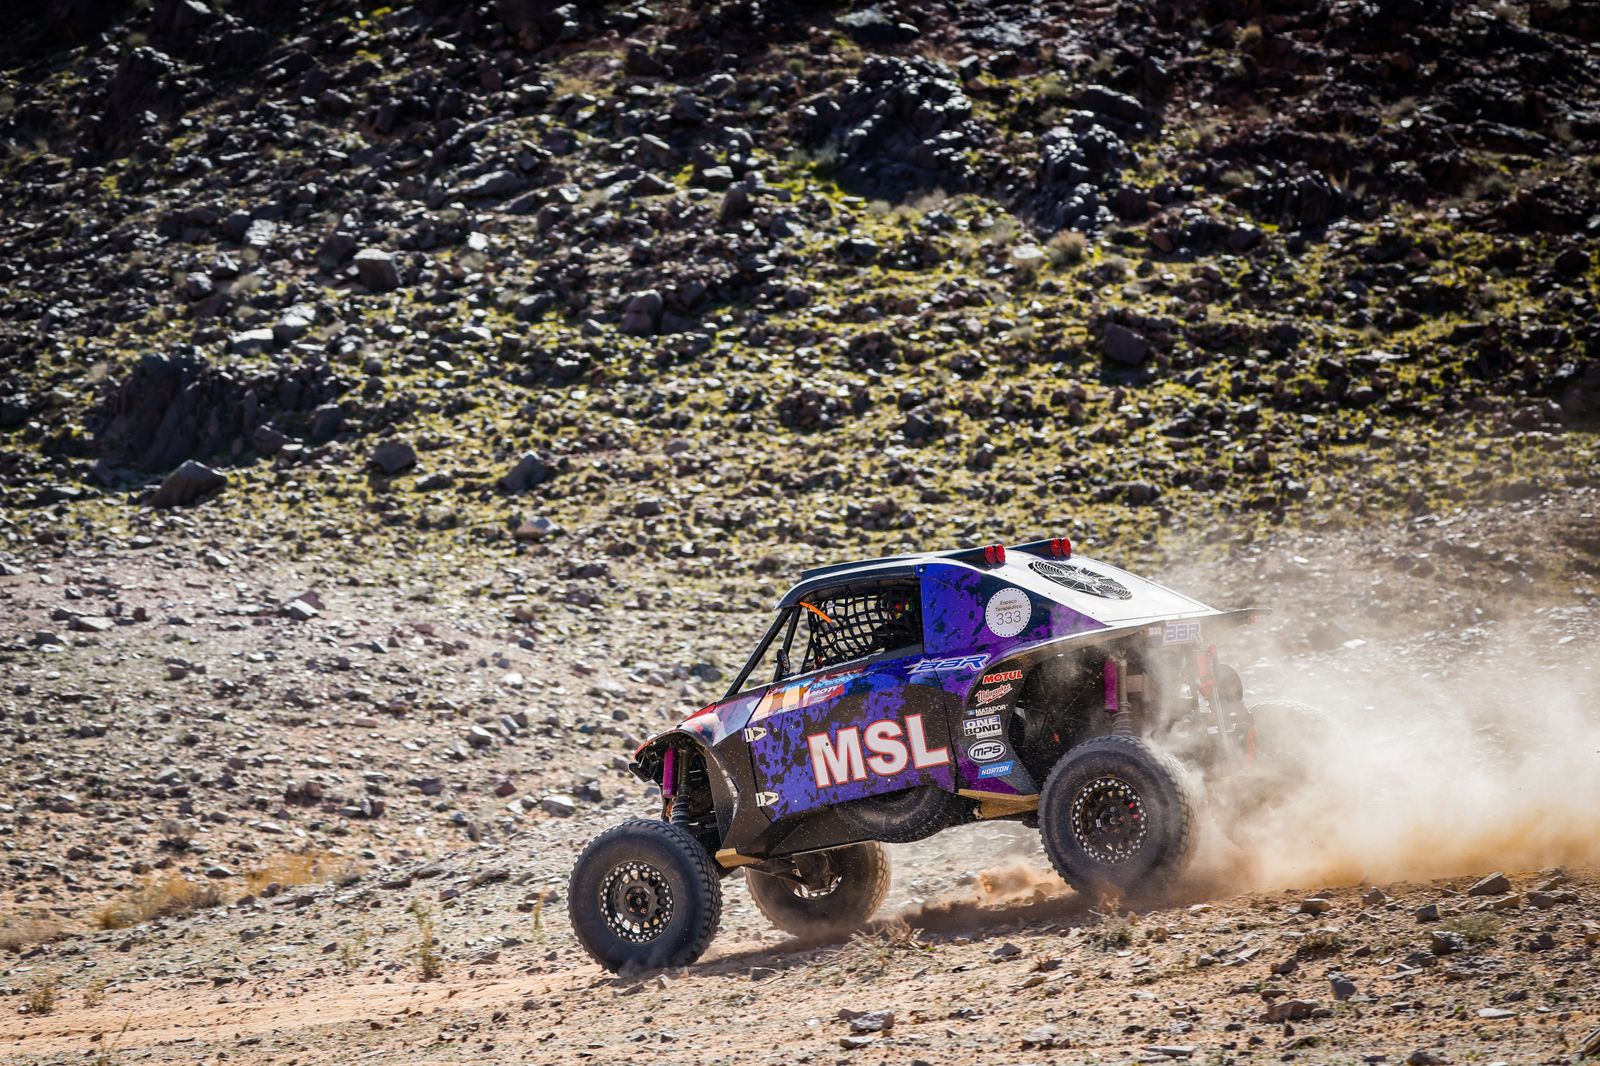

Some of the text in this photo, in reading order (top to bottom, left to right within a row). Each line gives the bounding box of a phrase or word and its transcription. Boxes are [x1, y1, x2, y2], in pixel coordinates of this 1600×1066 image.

[996, 610, 1022, 626] 333
[982, 670, 1023, 684] MOTUL
[975, 704, 1007, 715] MATADOR
[964, 717, 1000, 729] ONE
[965, 723, 1001, 735] BOND
[807, 713, 951, 789] MSL
[973, 745, 1002, 757] MPS
[981, 765, 1010, 776] NORTON
